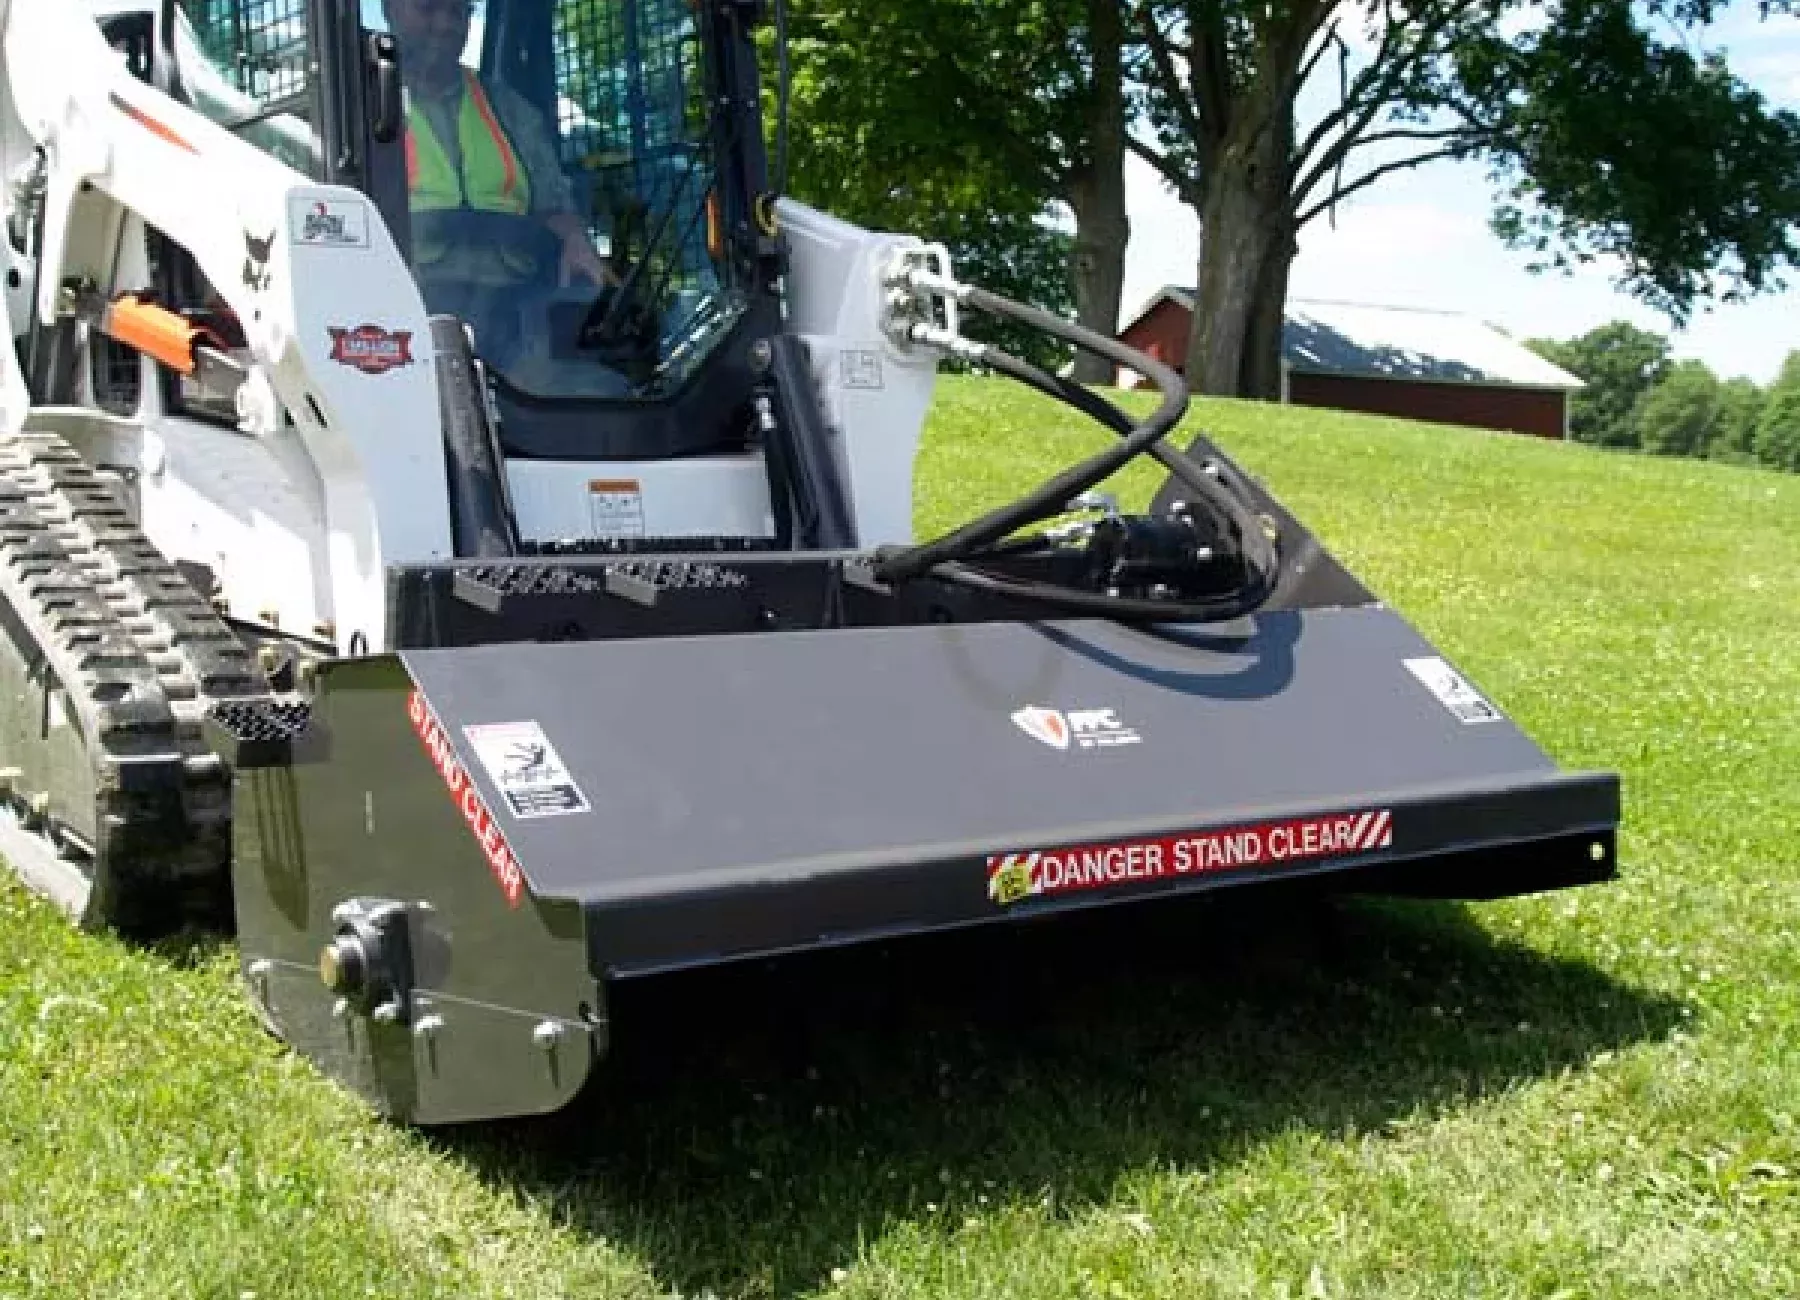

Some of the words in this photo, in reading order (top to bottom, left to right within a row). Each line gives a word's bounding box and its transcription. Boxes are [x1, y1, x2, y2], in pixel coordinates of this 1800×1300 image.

[462, 787, 521, 903] CLEAR
[1042, 844, 1163, 888] DANGER
[1172, 832, 1262, 872] STAND
[1268, 819, 1352, 858] CLEAR
